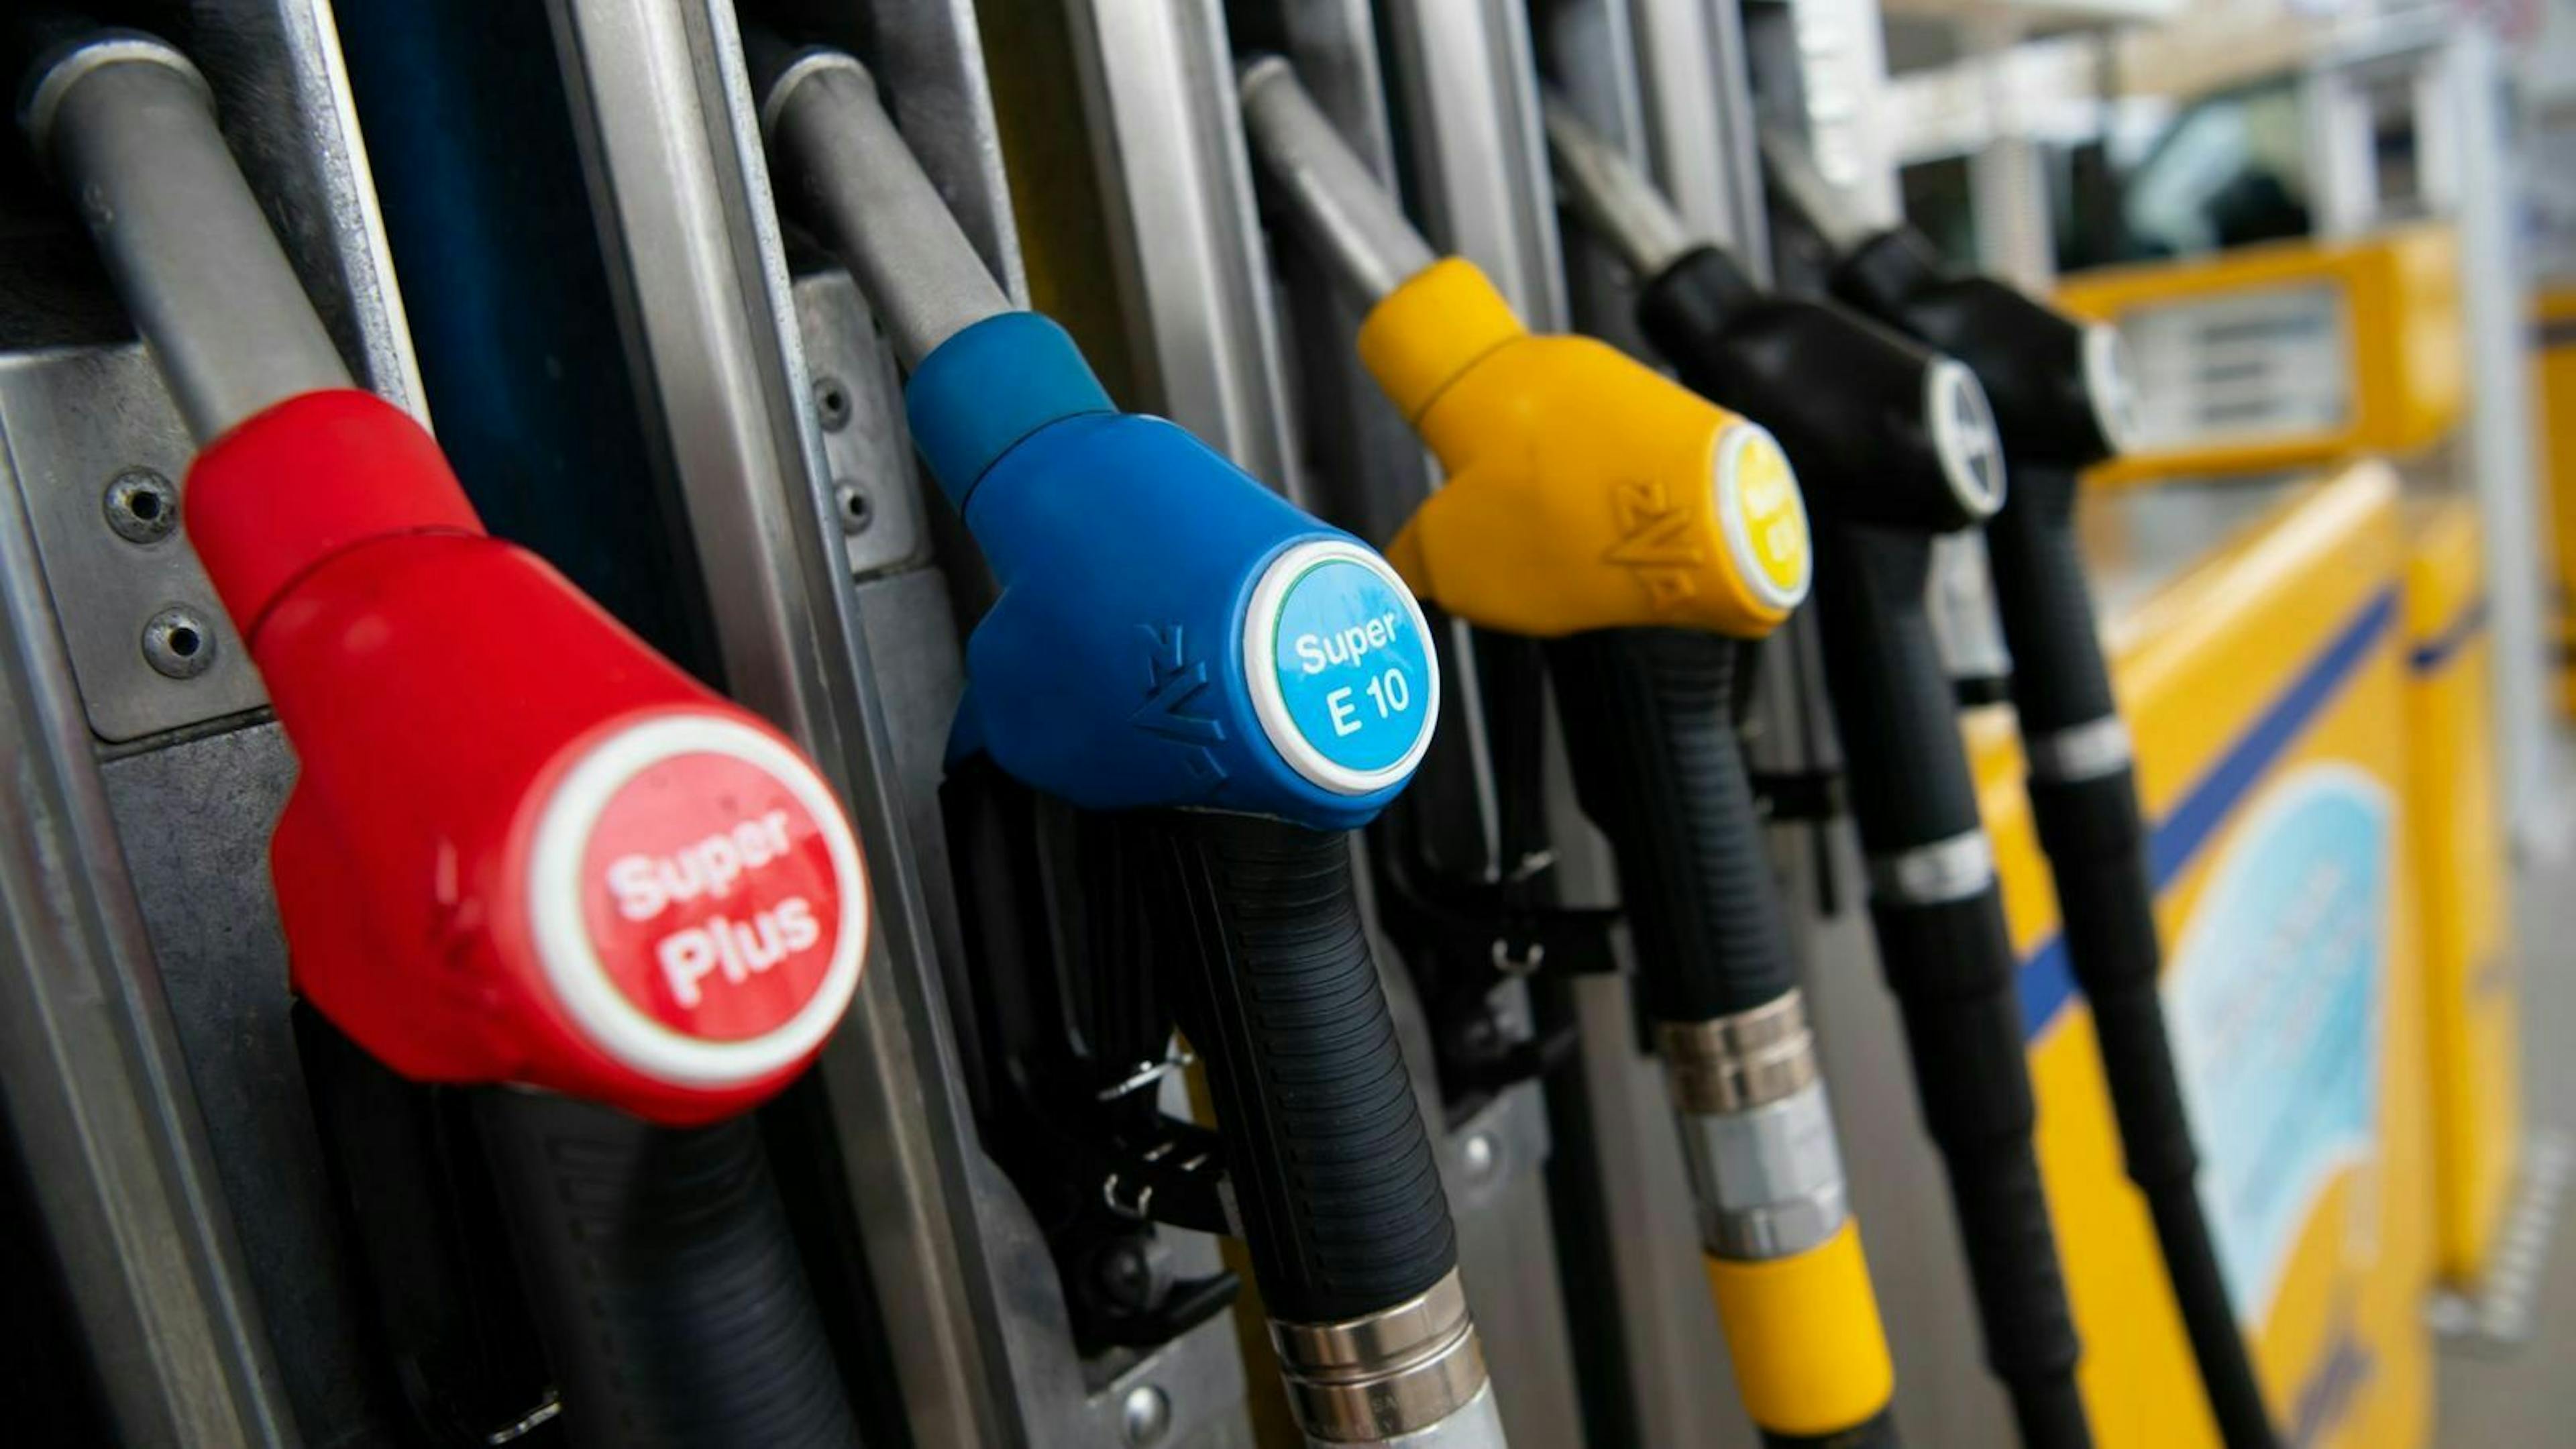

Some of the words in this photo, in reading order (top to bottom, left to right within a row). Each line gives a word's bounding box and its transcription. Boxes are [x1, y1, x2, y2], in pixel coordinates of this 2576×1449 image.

[1295, 611, 1397, 675] Super
[1326, 686, 1362, 737] E
[1366, 667, 1409, 719] 10
[607, 809, 790, 922] Super
[657, 896, 820, 1009] Plus
